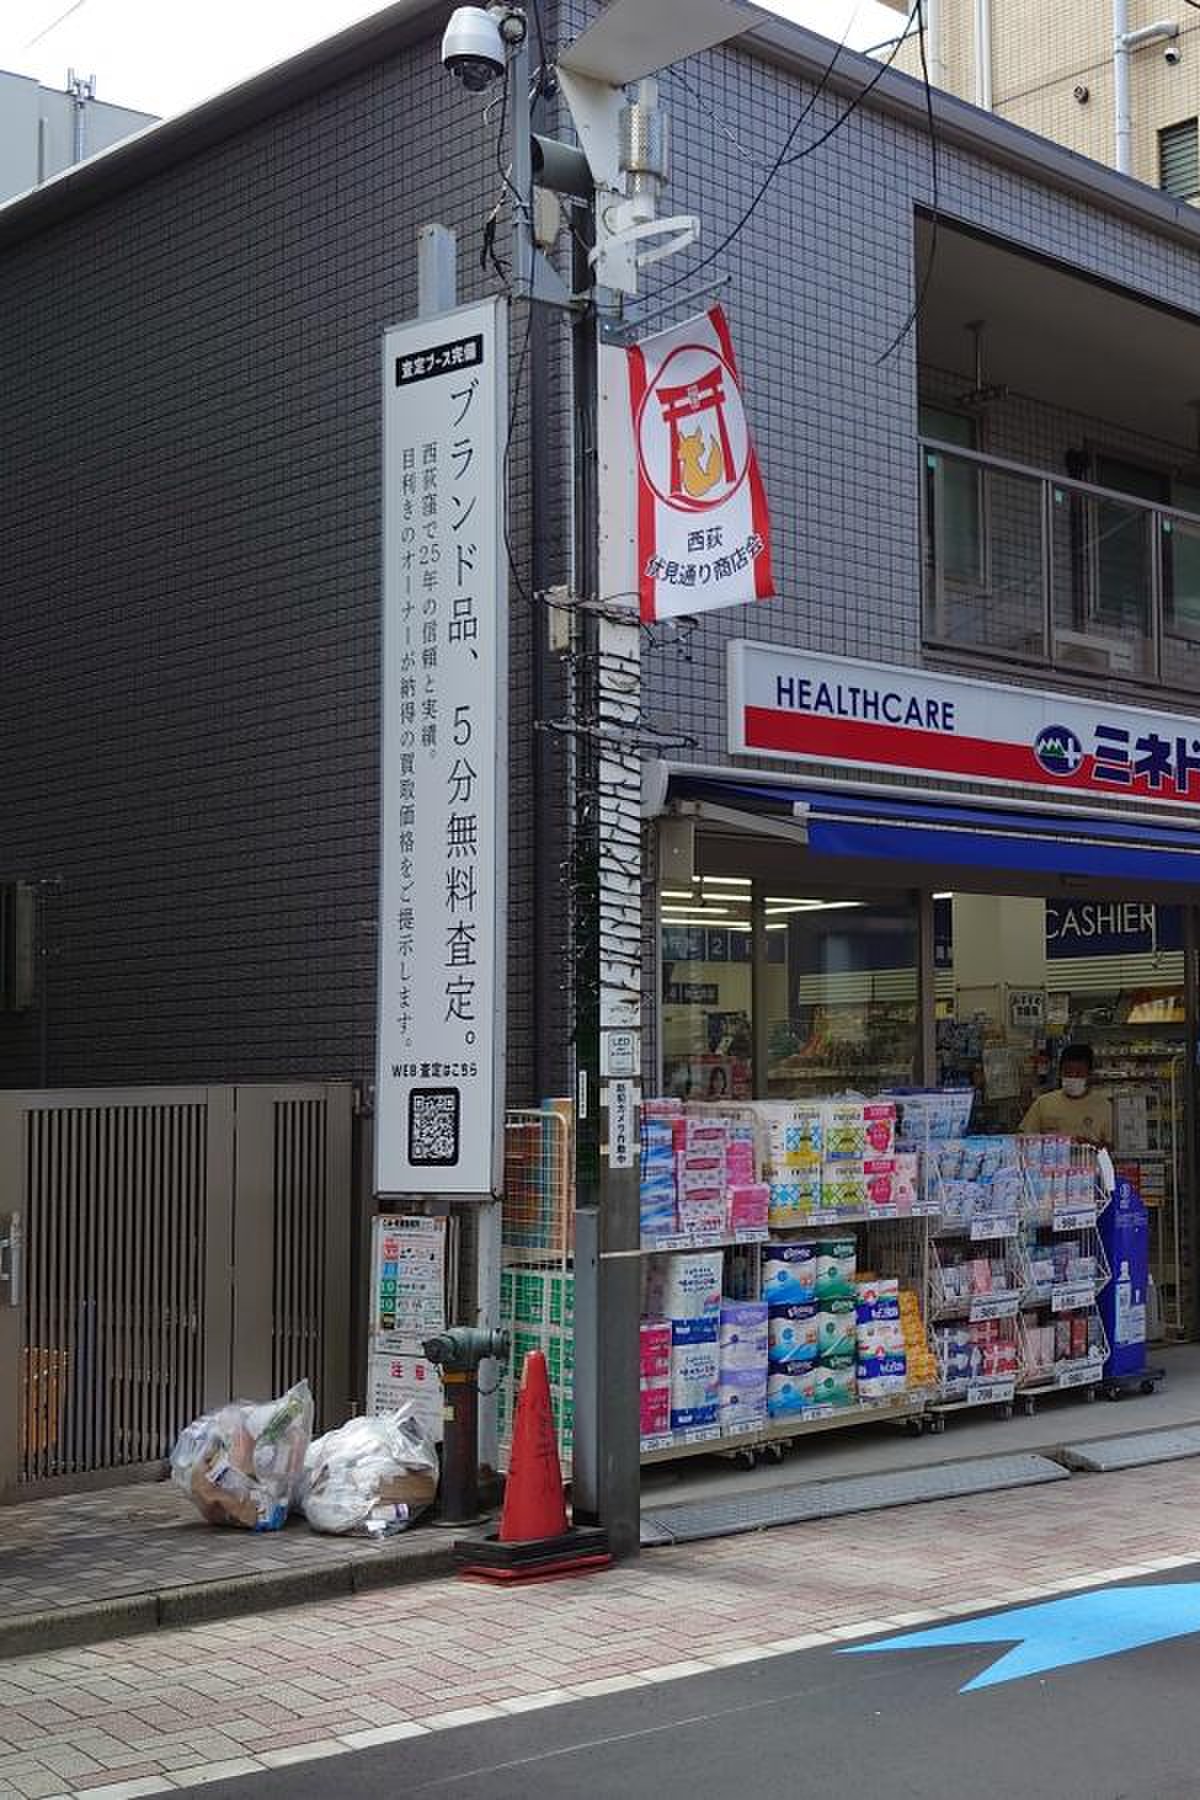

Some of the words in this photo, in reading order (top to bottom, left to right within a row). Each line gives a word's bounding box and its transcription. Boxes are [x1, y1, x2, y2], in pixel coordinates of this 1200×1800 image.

[645, 532, 764, 587] 伏見通り商店会
[687, 526, 723, 552] 西荻
[776, 675, 955, 731] HEALTHCARE
